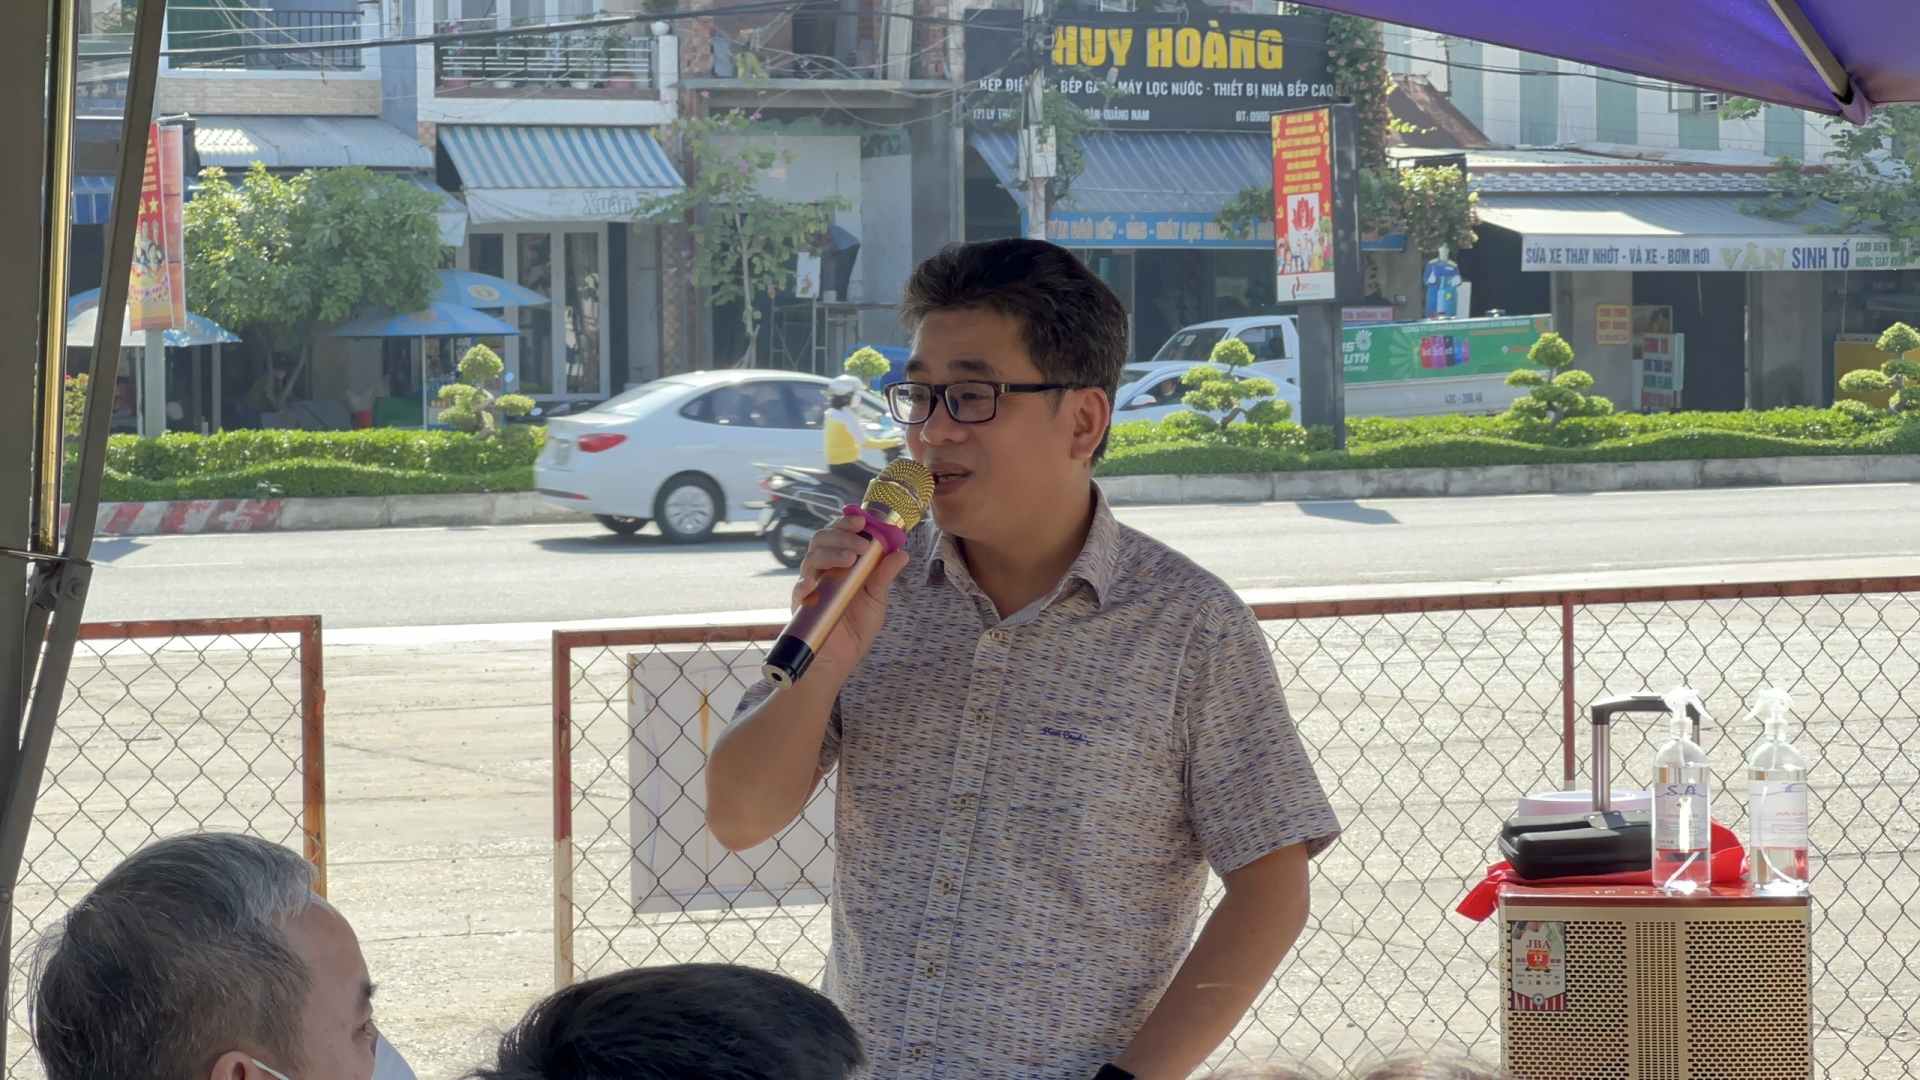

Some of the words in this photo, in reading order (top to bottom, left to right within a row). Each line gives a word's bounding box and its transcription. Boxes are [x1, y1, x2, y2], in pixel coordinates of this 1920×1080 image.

[1051, 25, 1133, 67] HUY
[1146, 19, 1284, 70] HOÀNG
[1060, 75, 1083, 94] BẾP
[1085, 80, 1106, 95] GA
[1118, 79, 1143, 95] MÁY
[1146, 80, 1168, 98] LỌC
[1171, 79, 1203, 96] NƯỚC
[1213, 78, 1243, 97] THIẾT
[1246, 82, 1259, 99] BỊ
[1261, 80, 1284, 98] NHÀ
[1287, 78, 1309, 98] BẾP
[1311, 83, 1334, 98] CAO
[1525, 242, 1546, 264] SỬA
[1549, 248, 1562, 264] XE
[1565, 248, 1590, 264] THAY
[1629, 244, 1643, 264] VÁ
[1645, 248, 1658, 264] XE
[1719, 241, 1786, 270] VÂN
[1791, 247, 1828, 269] SINH
[1832, 238, 1850, 269] TỐ
[1533, 954, 1543, 962] 12
